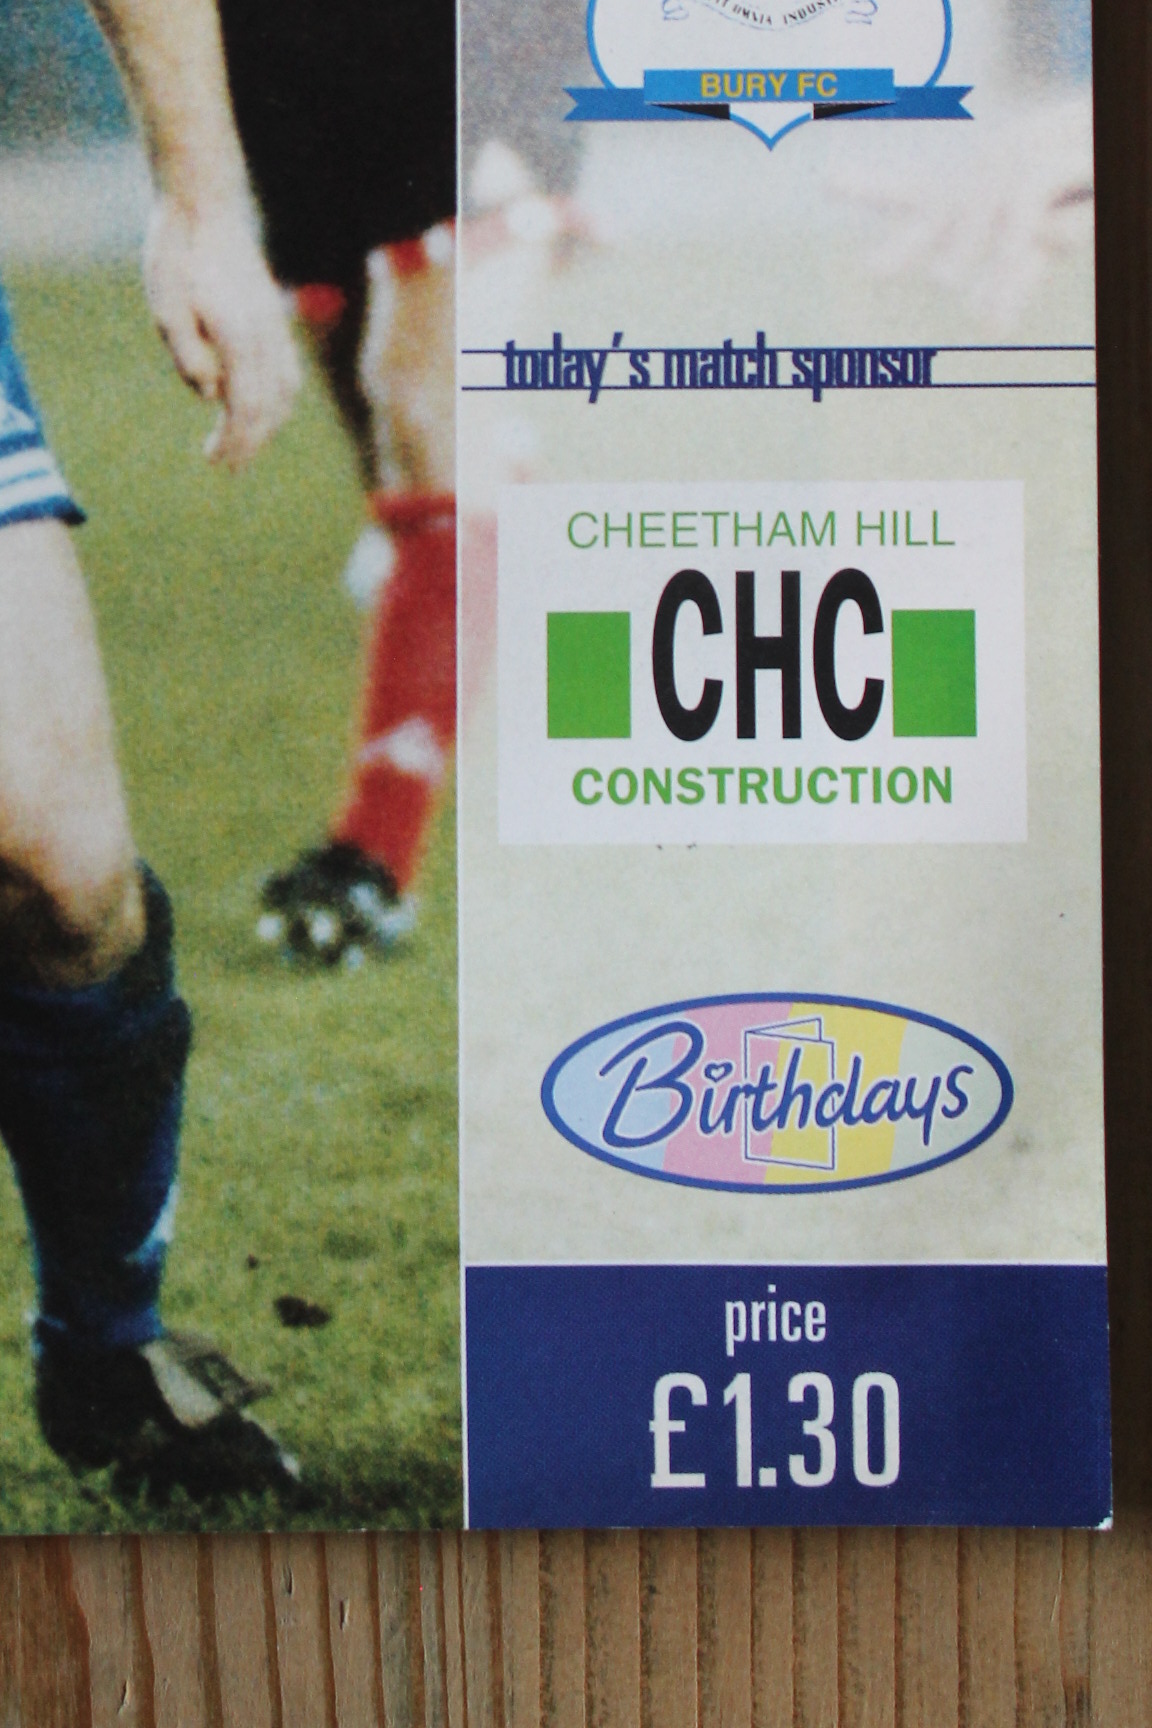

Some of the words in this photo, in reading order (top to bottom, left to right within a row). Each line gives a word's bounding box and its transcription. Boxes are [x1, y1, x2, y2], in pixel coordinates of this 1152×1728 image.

[701, 73, 787, 98] BURY
[798, 73, 838, 98] FC
[503, 332, 650, 404] today's
[664, 331, 779, 389] match
[792, 347, 937, 403] sponsor
[566, 510, 837, 550] CHEETHAM
[856, 509, 956, 547] HILL
[652, 567, 885, 742] CHC
[572, 766, 953, 806] CONSTRUCTION
[599, 1020, 974, 1148] Birthdays
[725, 1284, 827, 1357] price
[649, 1372, 901, 1488] £1.30
